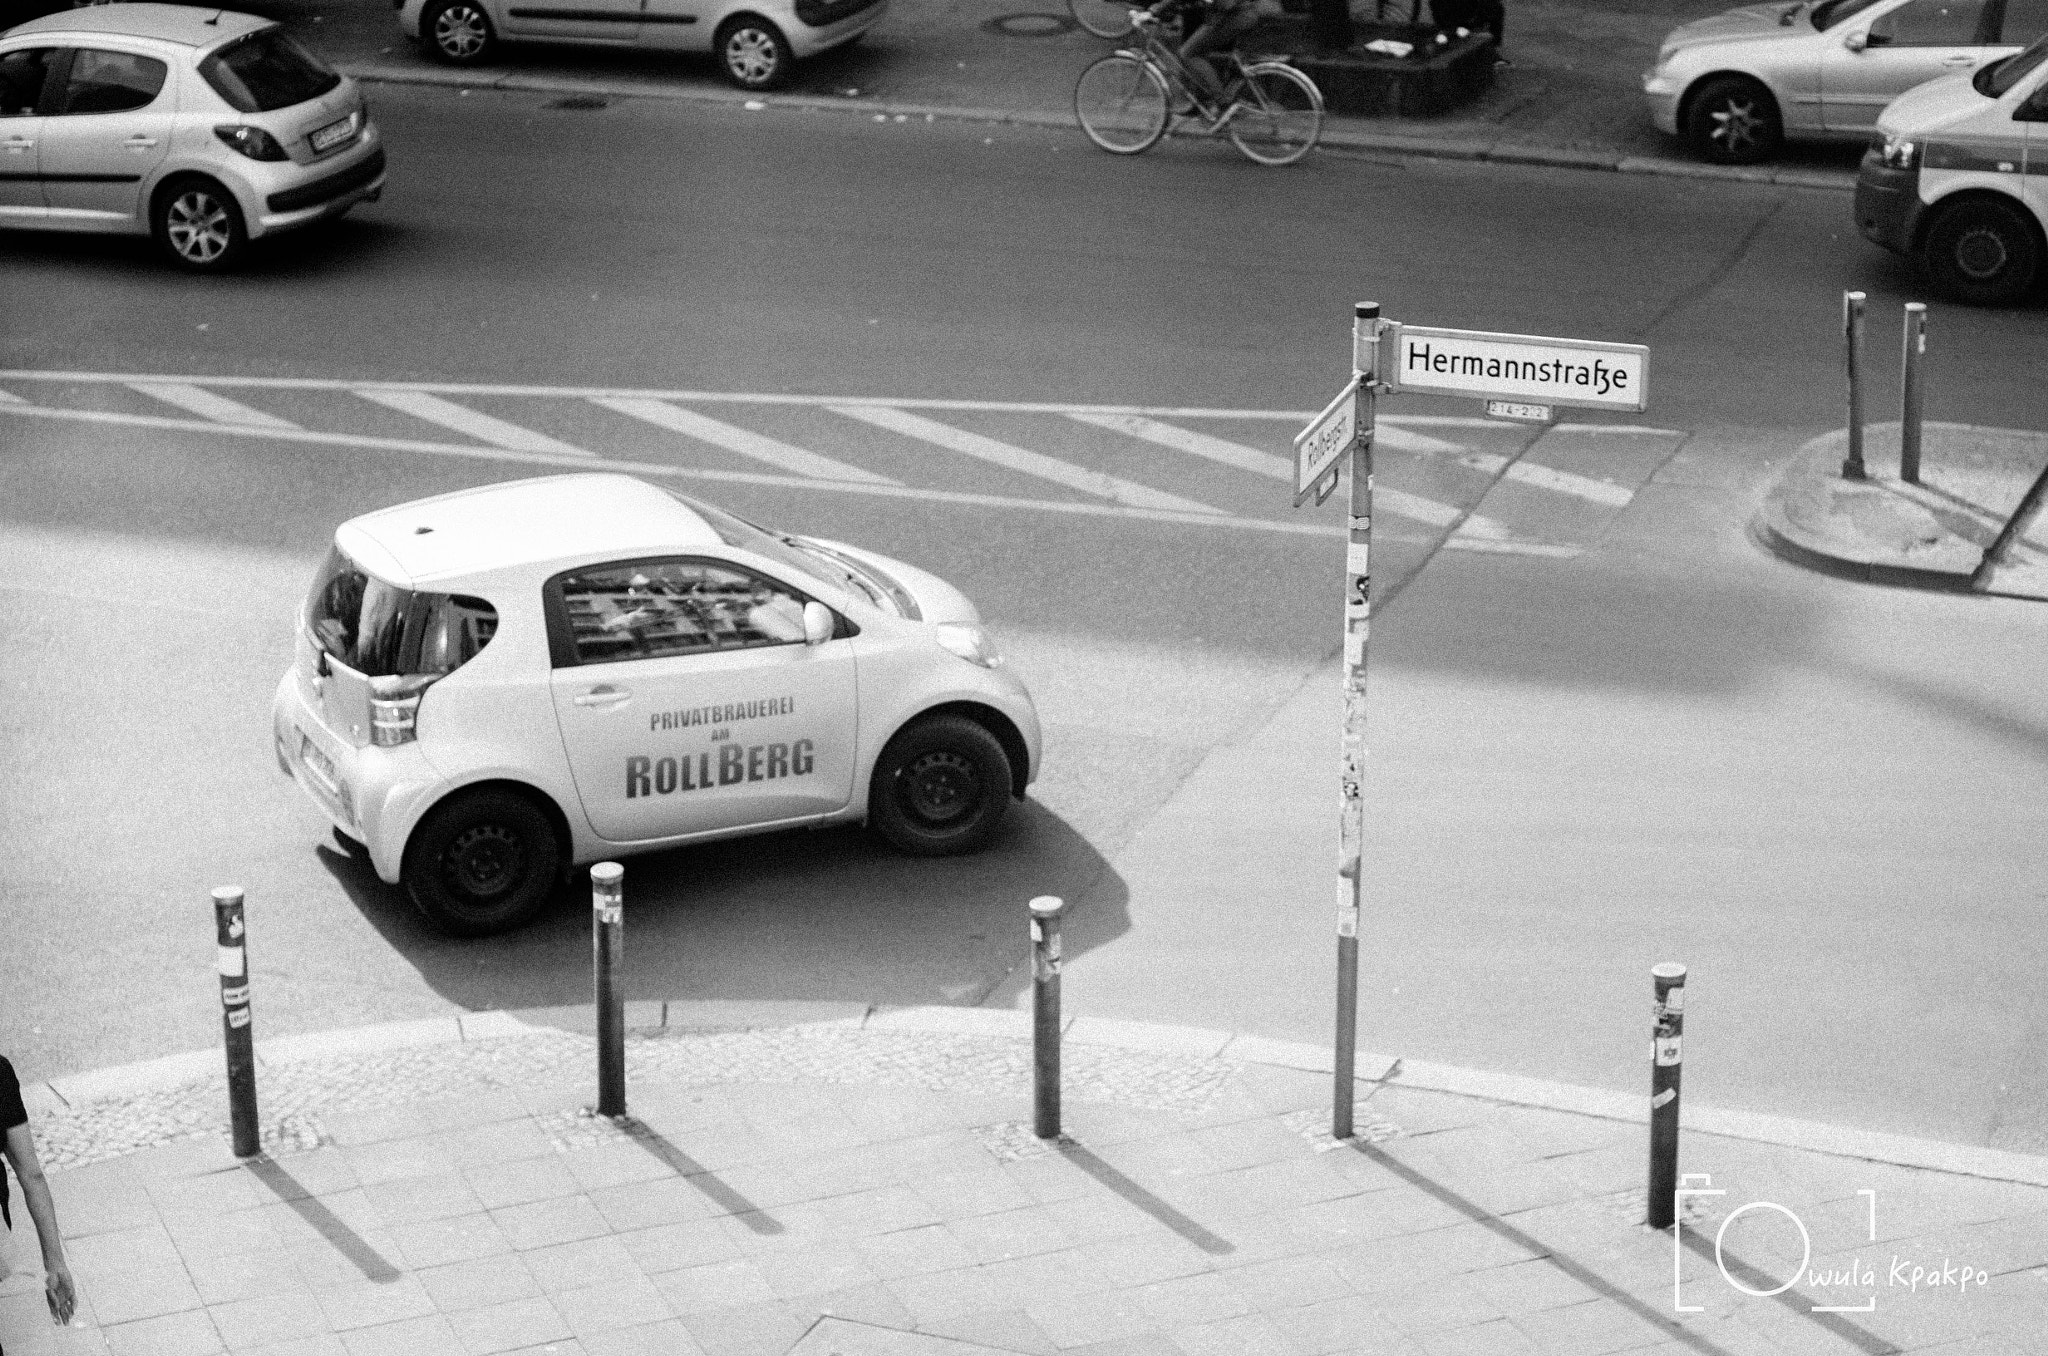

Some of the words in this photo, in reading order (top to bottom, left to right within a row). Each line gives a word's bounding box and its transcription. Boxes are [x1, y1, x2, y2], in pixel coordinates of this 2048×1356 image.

[1409, 342, 1628, 394] Hermannstraße
[650, 696, 794, 731] PRIVATBRAUEREI
[711, 728, 730, 742] AM
[626, 738, 814, 799] ROLLBERG
